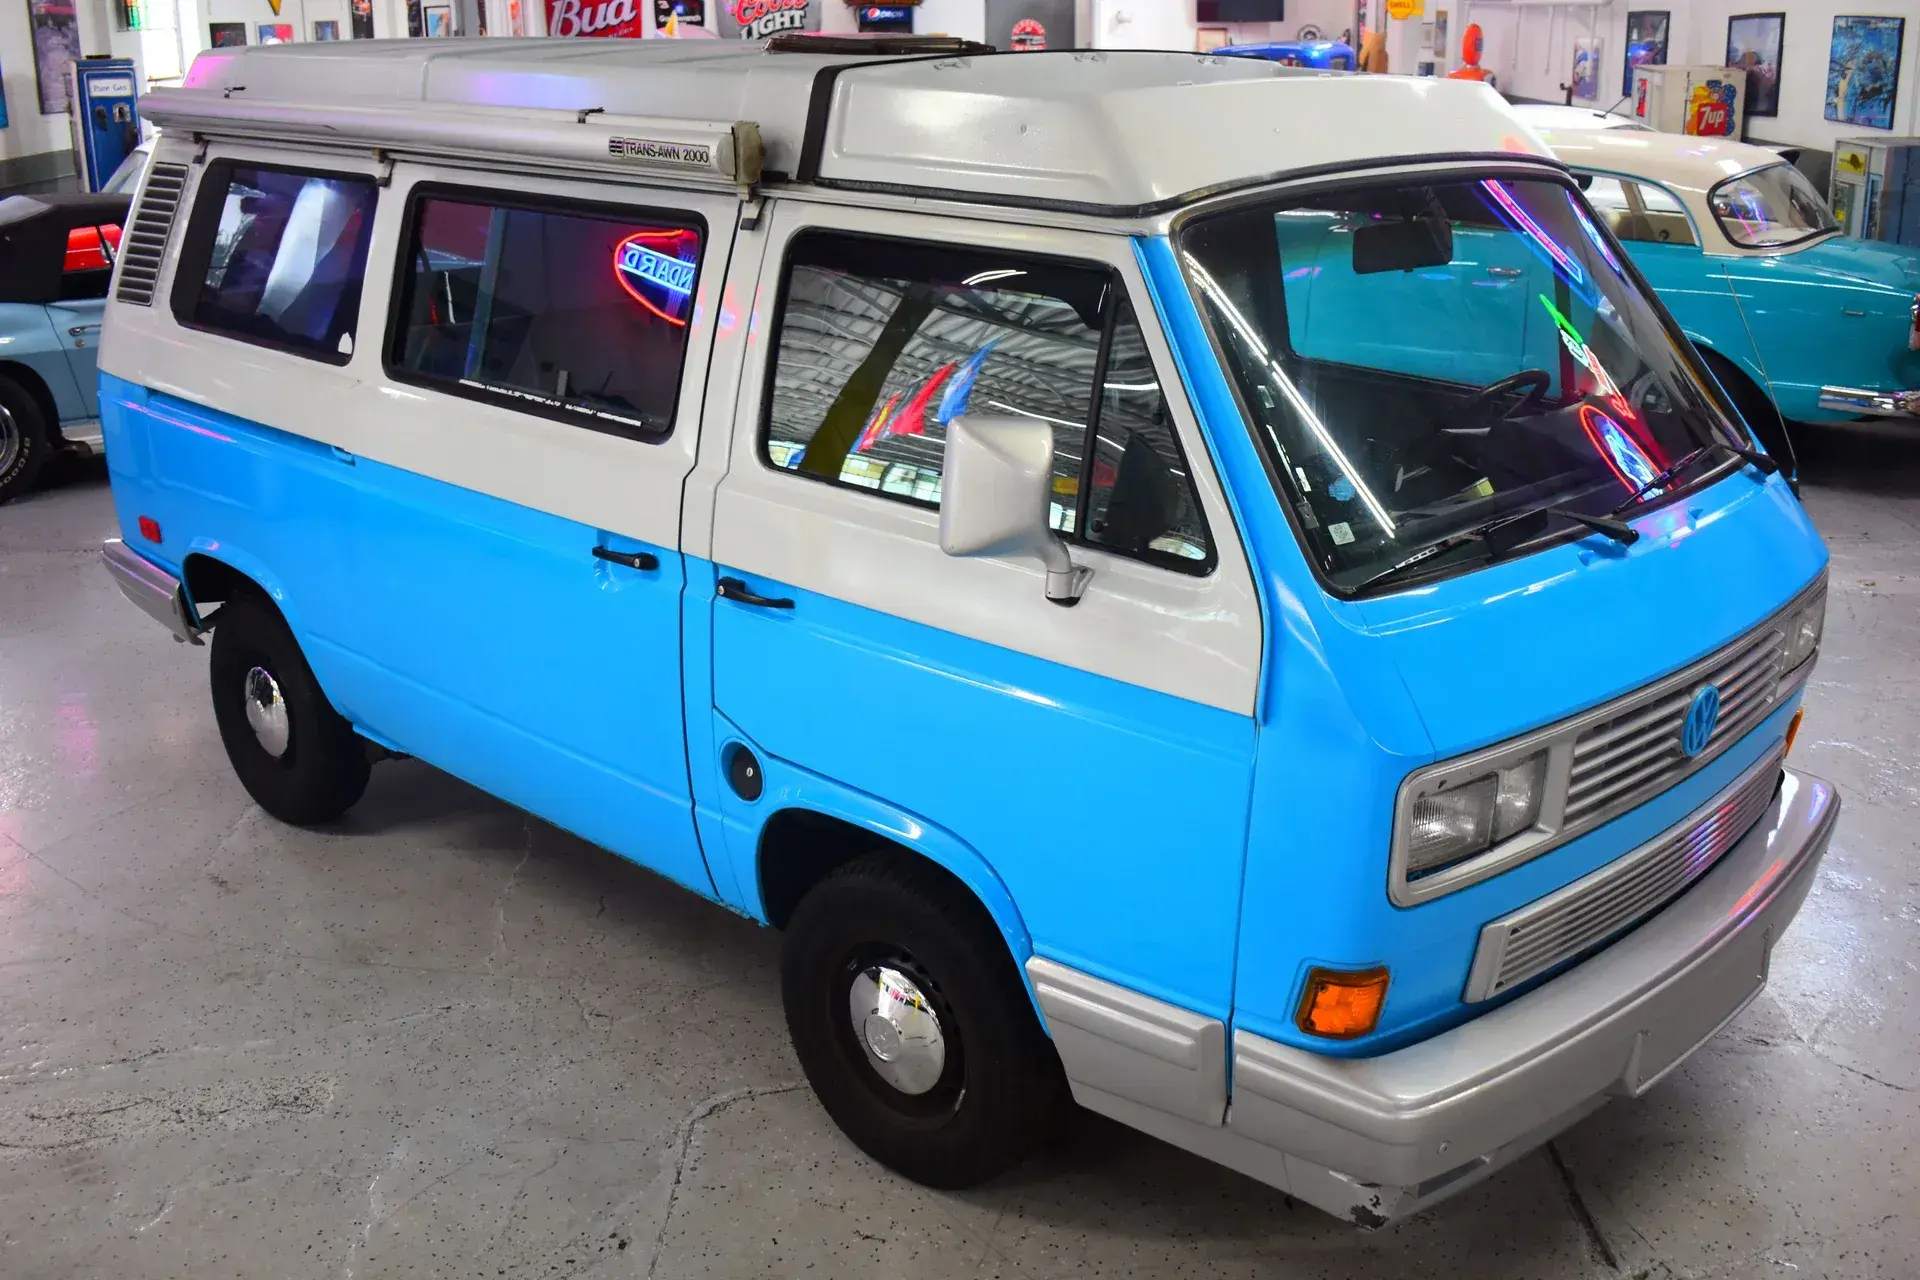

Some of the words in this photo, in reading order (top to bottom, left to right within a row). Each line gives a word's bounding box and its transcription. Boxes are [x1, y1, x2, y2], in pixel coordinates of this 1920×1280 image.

[741, 9, 805, 40] LIGHT
[624, 142, 680, 159] TRANS-AWN
[683, 149, 709, 163] 2000
